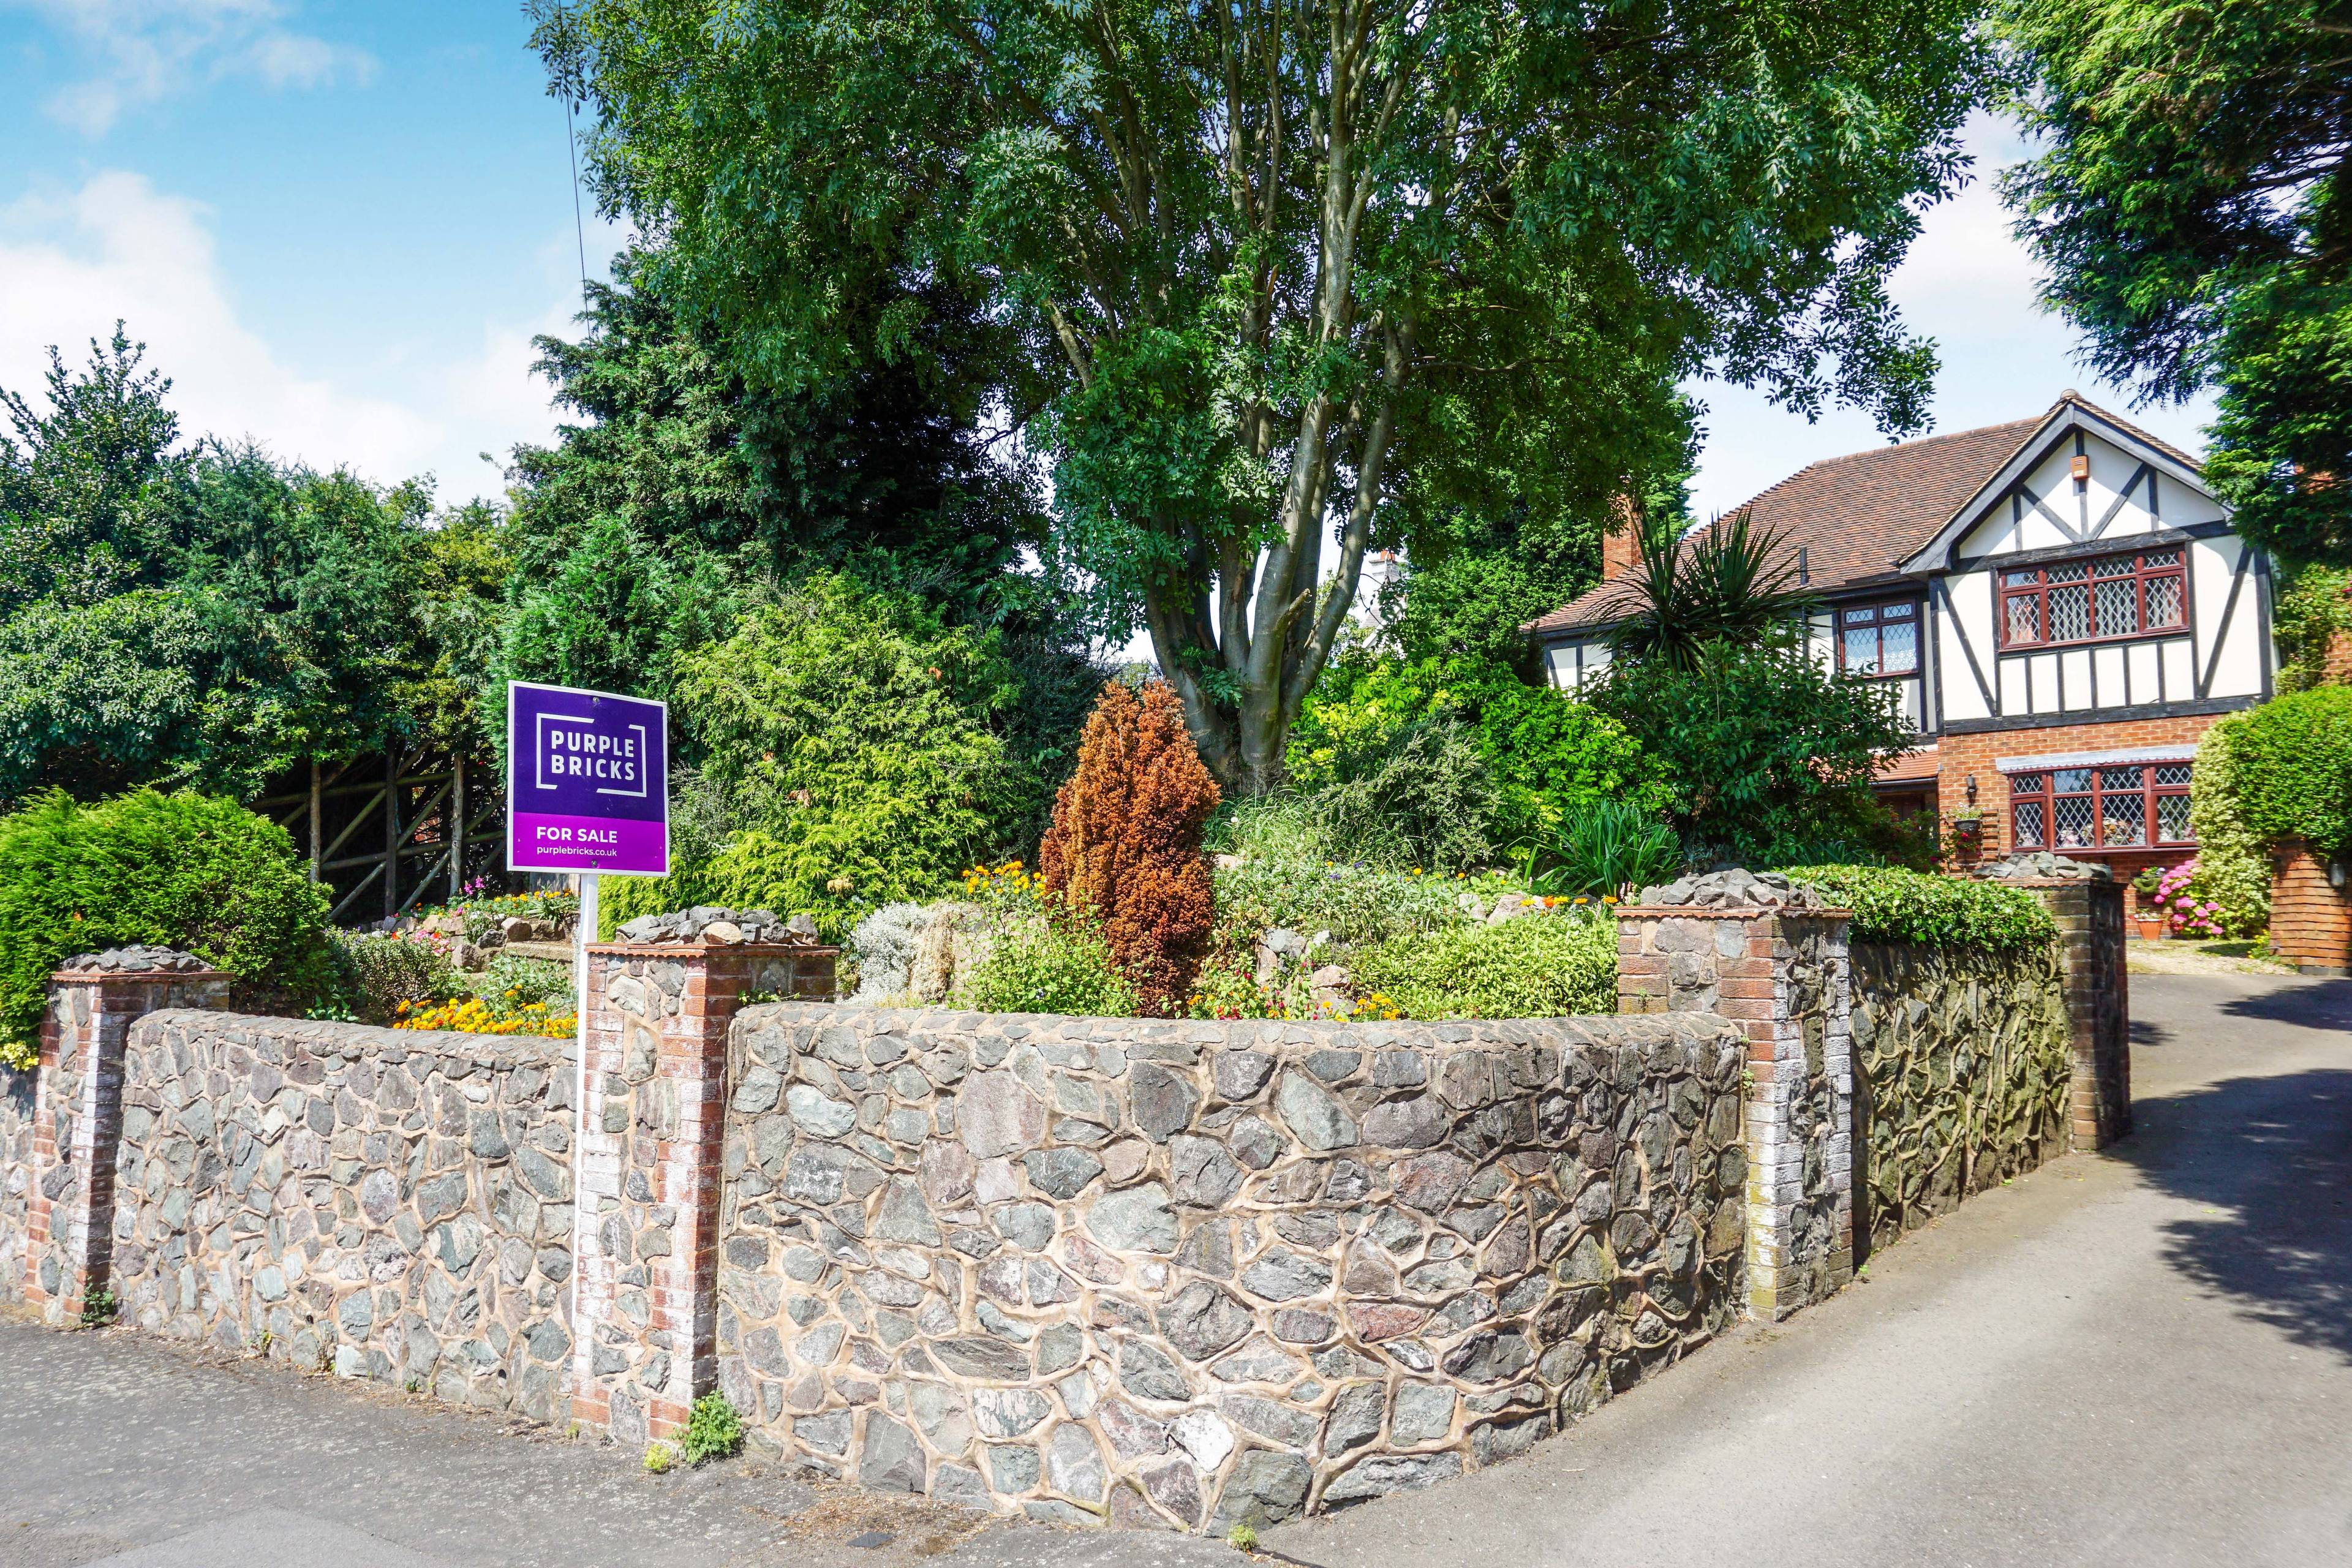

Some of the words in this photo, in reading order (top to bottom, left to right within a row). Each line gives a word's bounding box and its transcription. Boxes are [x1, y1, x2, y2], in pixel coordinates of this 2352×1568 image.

[551, 731, 634, 757] PURPLE
[551, 755, 635, 780] BRICKS
[537, 826, 572, 841] FOR
[577, 829, 617, 843] SALE
[537, 846, 617, 856] purplebricks.co.uk
